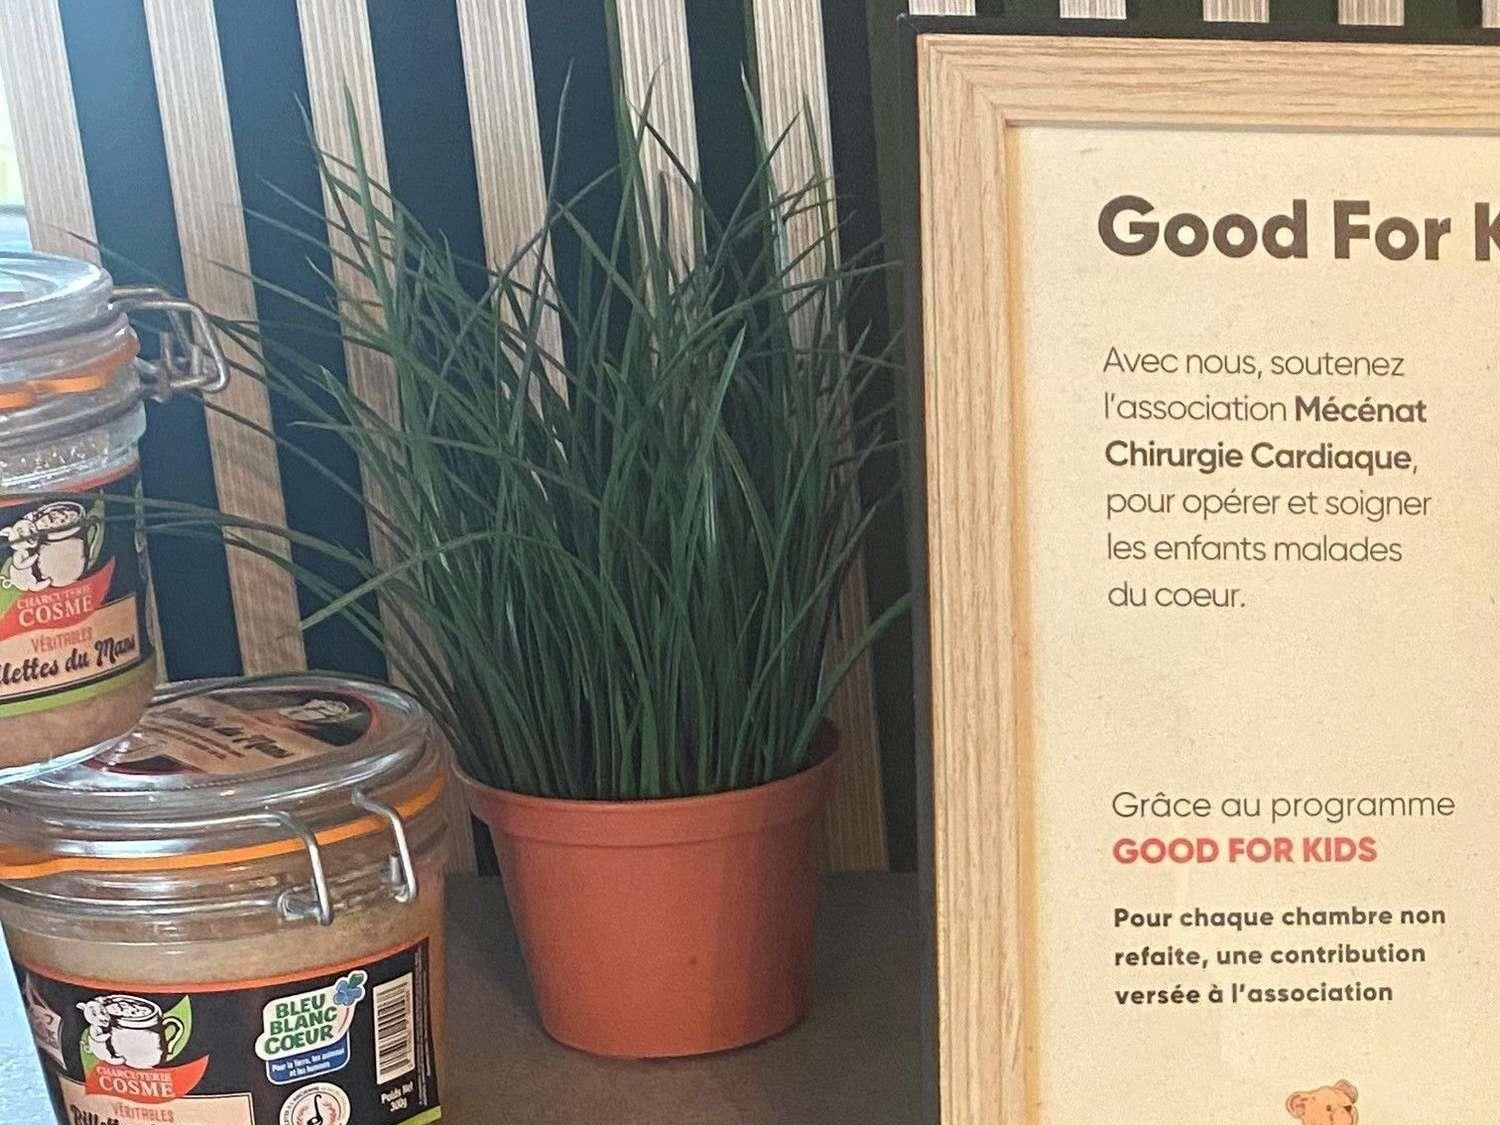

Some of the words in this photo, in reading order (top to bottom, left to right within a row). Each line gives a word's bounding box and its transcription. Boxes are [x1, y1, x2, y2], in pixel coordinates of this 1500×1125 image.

[1097, 194, 1309, 260] Good
[1333, 199, 1452, 262] For
[1102, 345, 1179, 375] Avec
[1186, 353, 1263, 380] nous,
[1270, 352, 1405, 378] soutenez
[1104, 391, 1287, 423] l'association
[1294, 395, 1428, 424] Mécénat
[1104, 440, 1244, 475] Chirurgie
[1250, 441, 1418, 476] Cardiaque,
[1106, 493, 1176, 521] pour
[1182, 487, 1281, 521] opérer
[1287, 491, 1319, 516] et
[1325, 489, 1433, 523] soigner
[1107, 531, 1147, 561] les
[1153, 533, 1267, 562] enfants
[1274, 534, 1403, 562] malades
[1107, 580, 1147, 608] du
[1154, 586, 1247, 609] coeur.
[18, 594, 94, 628] COSME
[65, 648, 90, 672] du
[94, 634, 137, 668] Mans
[1111, 790, 1212, 818] Grâce
[1220, 797, 1261, 818] au
[1271, 796, 1456, 825] programme
[1112, 837, 1220, 865] GOOD
[1228, 836, 1295, 864] FOR
[1302, 835, 1378, 863] KIDS
[1113, 907, 1173, 928] Pour
[1179, 906, 1275, 932] chaque
[1281, 905, 1393, 927] chambre
[1400, 909, 1446, 925] non
[1114, 945, 1209, 970] refaite,
[1216, 949, 1263, 966] une
[1270, 942, 1426, 965] contribution
[275, 993, 326, 1019] BLEU
[1114, 983, 1201, 1006] versée
[1207, 982, 1224, 1004] à
[1231, 981, 1393, 1005] l'association
[269, 1006, 338, 1037] BLANC
[98, 1076, 176, 1099] COSME
